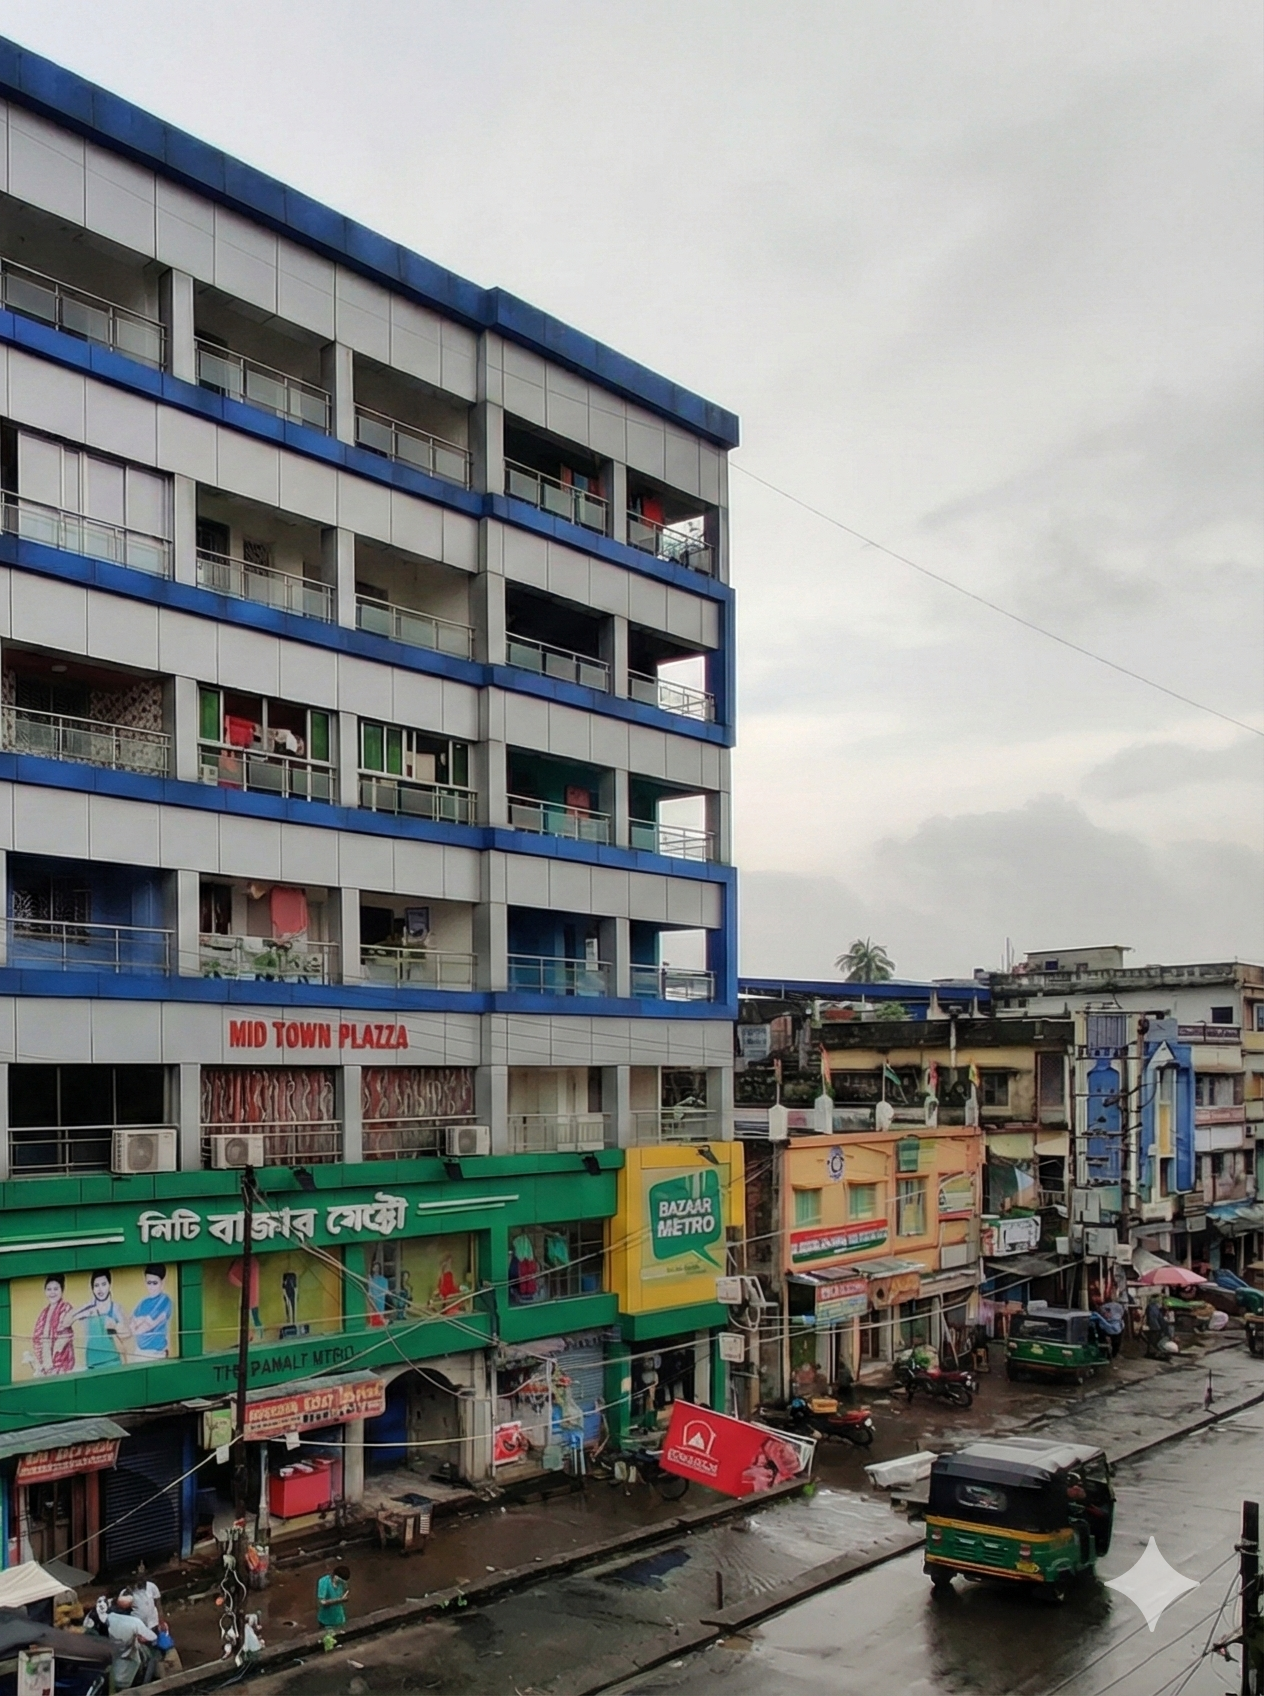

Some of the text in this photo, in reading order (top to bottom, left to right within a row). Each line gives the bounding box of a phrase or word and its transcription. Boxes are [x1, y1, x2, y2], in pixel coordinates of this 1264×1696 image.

[229, 1020, 409, 1050] MID TOWN PLAZZA
[658, 1197, 712, 1218] BAZAAR
[656, 1215, 716, 1238] METRO
